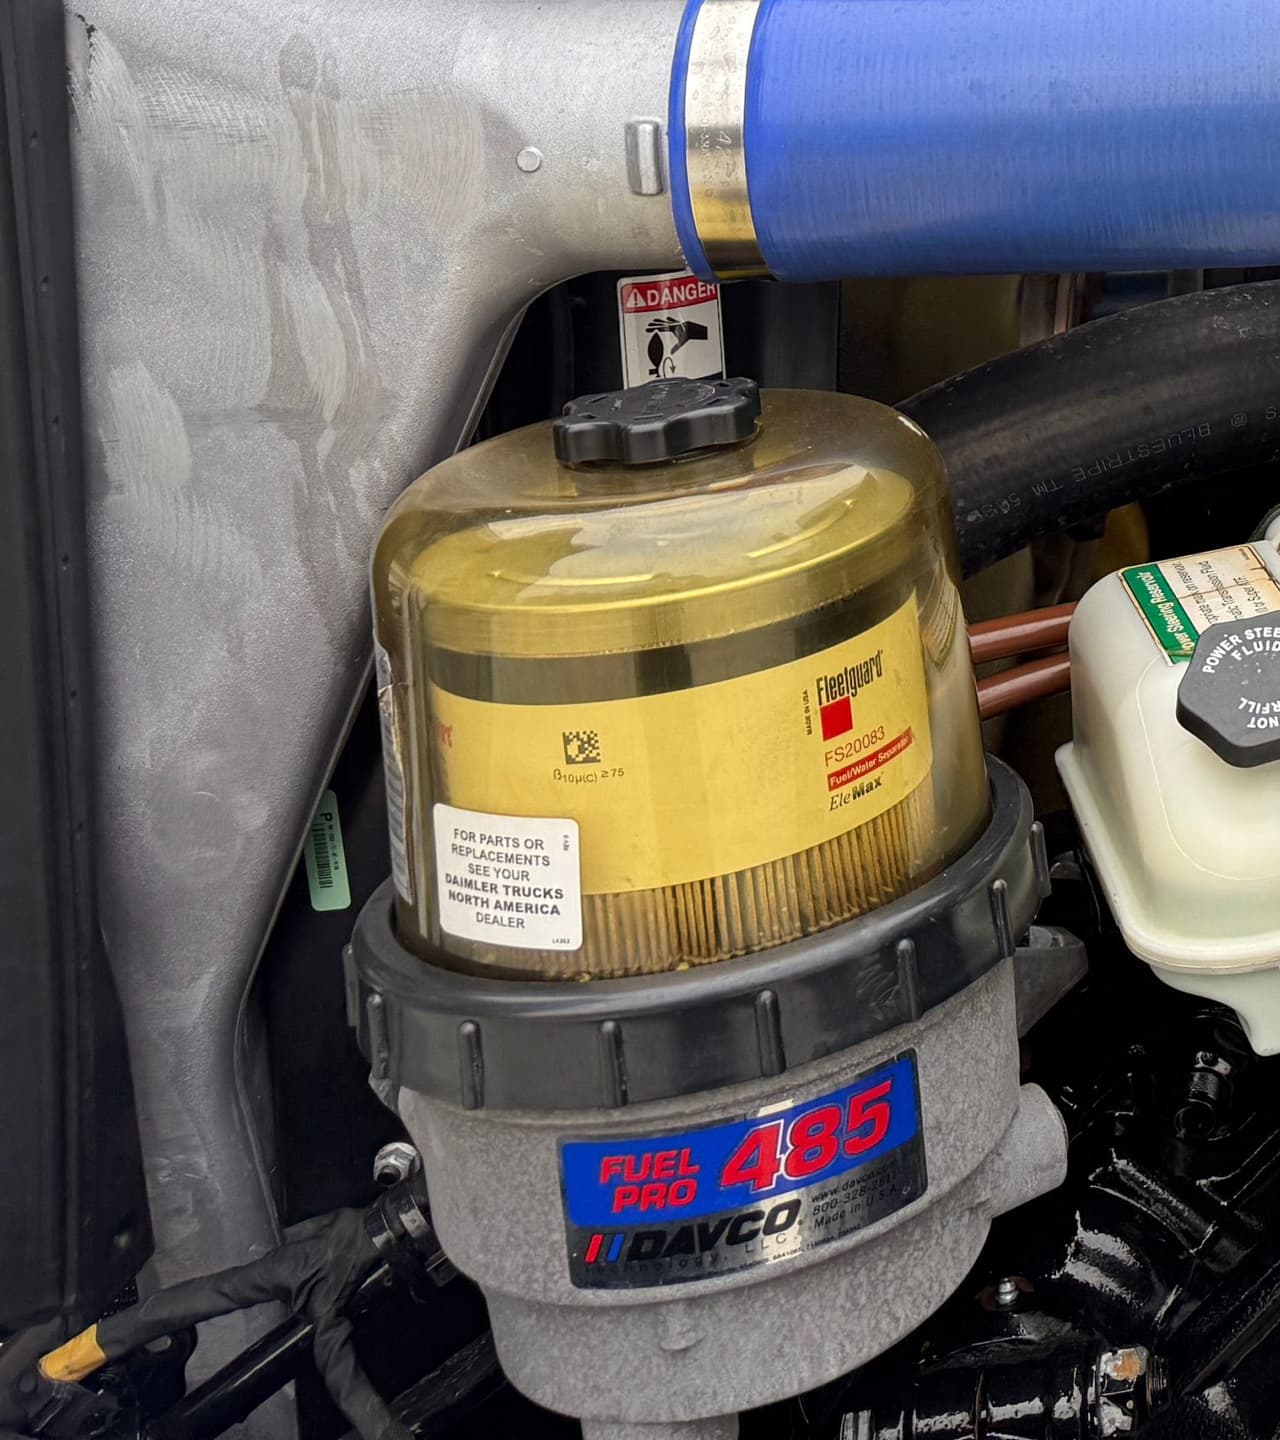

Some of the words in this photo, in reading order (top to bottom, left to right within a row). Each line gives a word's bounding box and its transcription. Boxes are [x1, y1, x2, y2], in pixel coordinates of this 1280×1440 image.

[646, 282, 716, 306] DANGER
[1072, 422, 1212, 482] BLUESTRIPE
[1195, 560, 1214, 574] Fluid
[1134, 570, 1168, 603] Reservoir
[1153, 603, 1187, 632] Steering
[1202, 634, 1242, 674] POWER
[816, 650, 882, 706] Fleetguard
[1247, 716, 1279, 729] NOT
[824, 725, 885, 767] FS20083
[829, 759, 877, 788] Fuel/Water
[877, 735, 910, 763] Separator
[454, 828, 476, 843] FOR
[480, 834, 520, 848] PARTS
[524, 839, 544, 850] OR
[451, 843, 550, 867] REPLACEMENTS
[445, 873, 499, 895] DAIMLER
[502, 885, 564, 900] TRUCKS
[468, 863, 490, 877] SEE
[493, 867, 530, 881] YOUR
[448, 889, 490, 909] NORTH
[494, 899, 561, 916] AMERICA
[476, 912, 525, 929] DEALER
[600, 1147, 700, 1184] FUEL
[720, 1079, 892, 1192] 485
[612, 1179, 698, 1213] PRO
[811, 1161, 897, 1203] www.davco.com
[626, 1198, 802, 1261] DAVCO
[814, 1209, 848, 1230] Made
[850, 1207, 864, 1221] in
